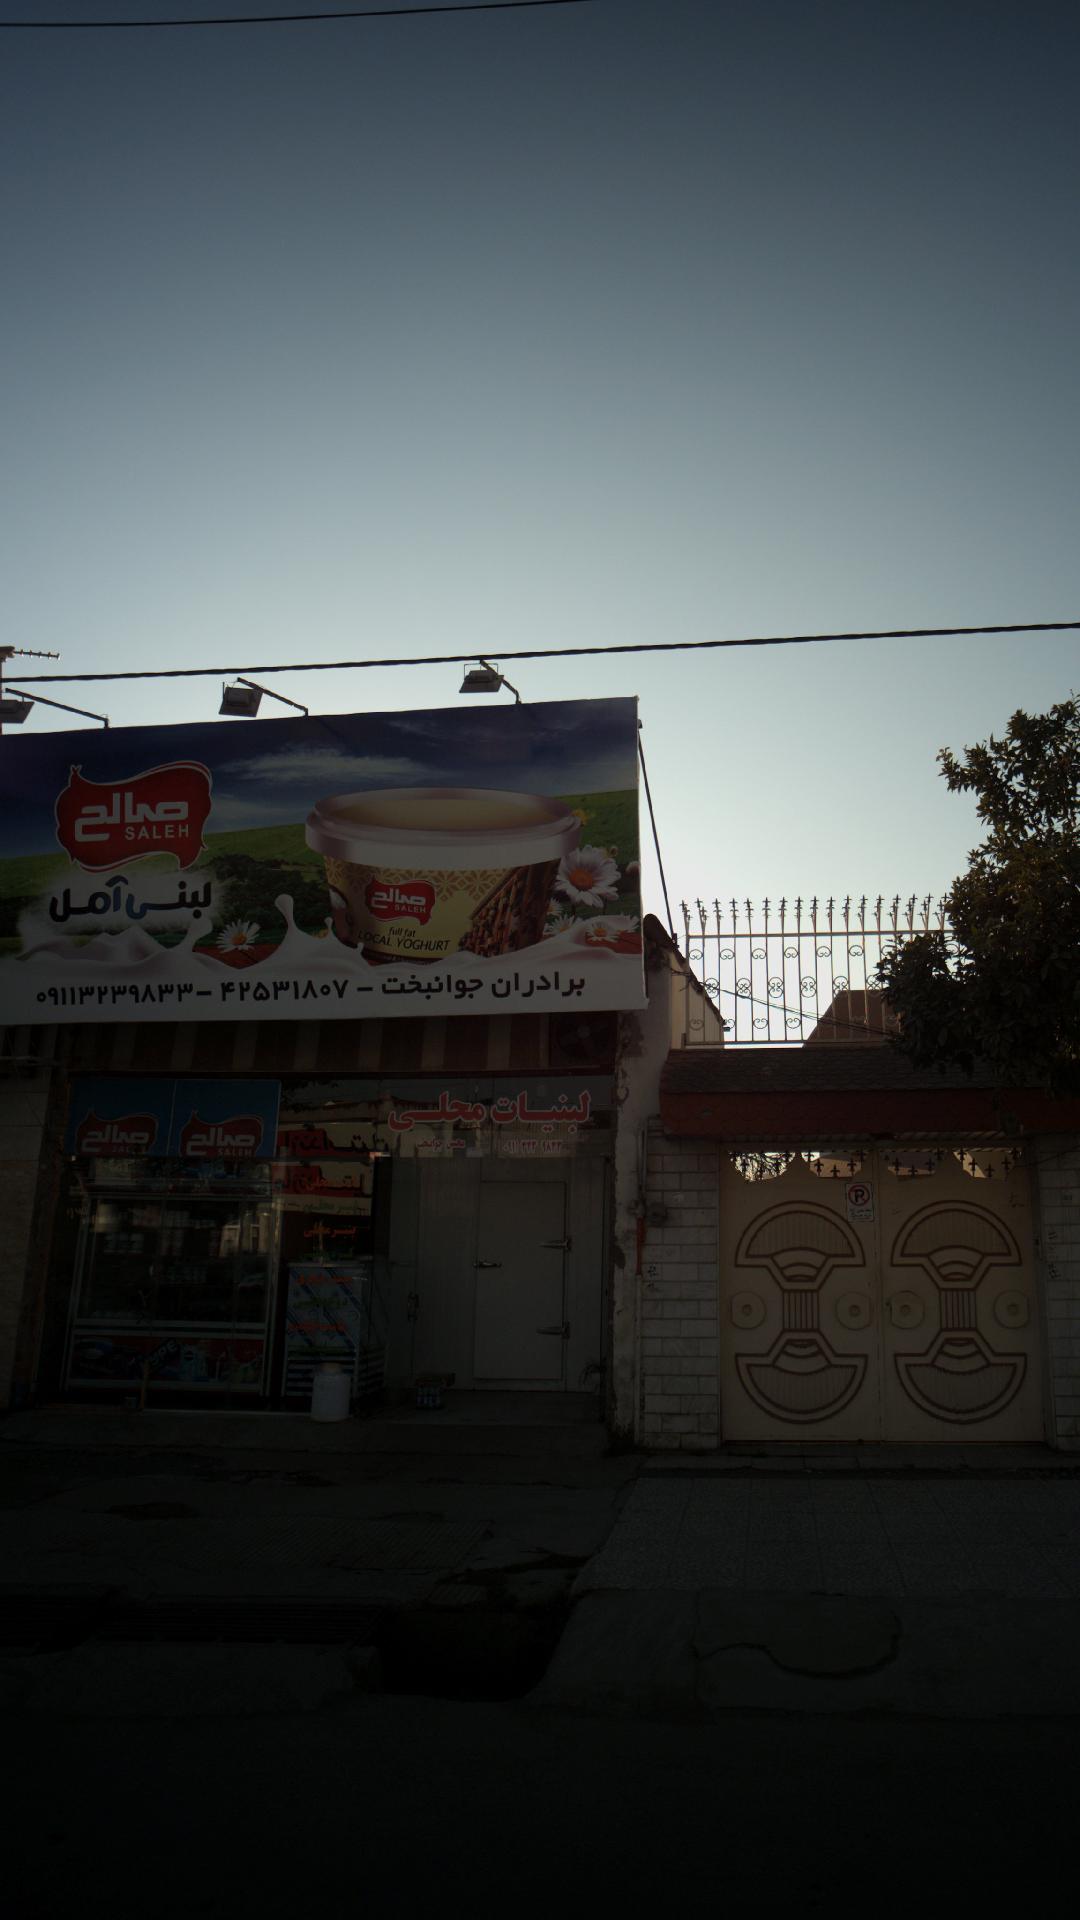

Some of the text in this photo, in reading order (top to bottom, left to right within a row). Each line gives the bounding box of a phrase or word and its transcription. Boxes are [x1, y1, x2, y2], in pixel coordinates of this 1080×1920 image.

[75, 792, 189, 843] صالح
[124, 824, 190, 840] SALEH
[50, 875, 211, 922] لبنی آمل
[371, 888, 426, 909] صالح
[395, 903, 427, 913] SALEH
[358, 929, 450, 951] LOCAL YOGHURT
[388, 926, 416, 937] full fat
[36, 982, 194, 1005] ۰۹۱۱۳۲۳۹۸۳۳
[221, 979, 348, 1001] ۴۲۵۳۱۸۰۷
[381, 974, 484, 1000] جوانبخت
[491, 971, 585, 998] برادران
[491, 1089, 591, 1134] لبنیات
[81, 1124, 150, 1153] صالح
[186, 1127, 256, 1156] صالح
